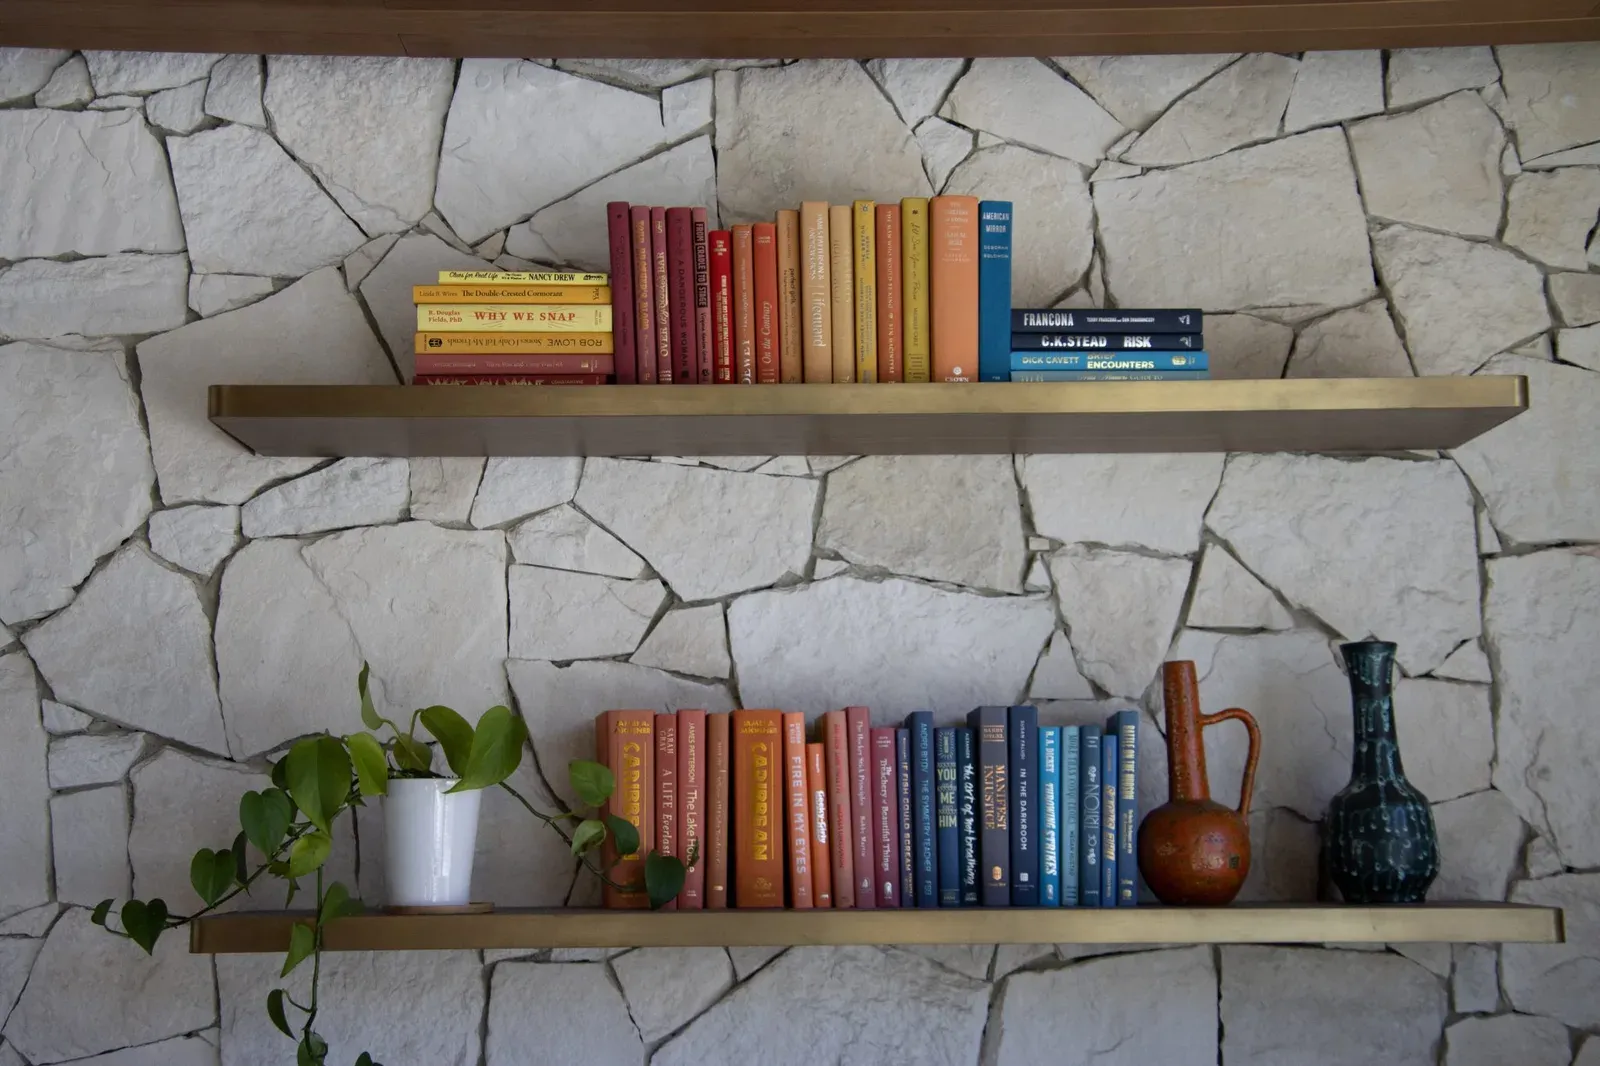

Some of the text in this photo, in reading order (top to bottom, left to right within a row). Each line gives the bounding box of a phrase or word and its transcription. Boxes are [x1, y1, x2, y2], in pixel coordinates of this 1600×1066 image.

[982, 212, 1010, 221] AMERICAN
[985, 225, 1006, 233] MIRROR
[696, 223, 708, 307] FROM CRADLE TO STAGE
[910, 253, 922, 269] You
[464, 272, 473, 280] for
[488, 272, 498, 281] Life
[475, 289, 526, 297] Double-Crested
[678, 269, 687, 328] DANGEROUS
[656, 252, 670, 357] OVER BAR
[428, 316, 448, 324] Fields,
[475, 312, 576, 321] WHY WE SNAP
[812, 292, 826, 347] Lifeguard
[1024, 313, 1074, 327] FRANCONA
[447, 338, 472, 347] Friends
[472, 337, 484, 346] My
[547, 339, 602, 347] ROB LOWE
[761, 301, 772, 364] On the Contrary
[1042, 336, 1152, 348] C.K.STEAD RISK
[1087, 361, 1155, 369] ENCOUNTERS
[856, 720, 864, 732] The
[1122, 725, 1135, 748] BATTLE
[688, 722, 696, 783] JAMES PATTERSON
[1045, 730, 1055, 773] R. A. DICKEY
[1067, 735, 1077, 754] MORE
[1122, 750, 1135, 758] ON
[857, 757, 865, 773] Stick
[901, 762, 909, 772] IF
[920, 750, 929, 773] BITOV
[963, 764, 974, 780] the
[1122, 760, 1135, 772] THE
[879, 759, 889, 798] Treachery
[902, 773, 910, 795] FISH
[937, 769, 956, 781] YOU
[1020, 768, 1027, 778] IN
[662, 769, 672, 809] A LIFE
[940, 792, 955, 804] ME
[964, 782, 975, 801] art
[983, 765, 995, 830] INJUSTICE
[996, 764, 1007, 830] MANIFEST
[1122, 774, 1135, 800] HUDSON
[751, 742, 768, 861] CARIBBEAN
[961, 803, 974, 815] of
[1084, 784, 1100, 829] TRITON
[686, 790, 698, 836] The Lake
[792, 756, 807, 874] FIRE IN MY EYES
[817, 790, 827, 844] Geeky-Girly
[881, 806, 890, 842] Beautiful
[903, 798, 911, 830] COULD
[939, 815, 958, 828] HIM
[921, 780, 932, 872] THE SYMMETRY TEACHER
[963, 818, 975, 834] not
[1020, 800, 1028, 851] DARKROOM
[1044, 782, 1058, 876] THROWING STRIKES
[881, 844, 891, 872] Things
[904, 833, 912, 872] SCREAM
[963, 836, 976, 885] breathing
